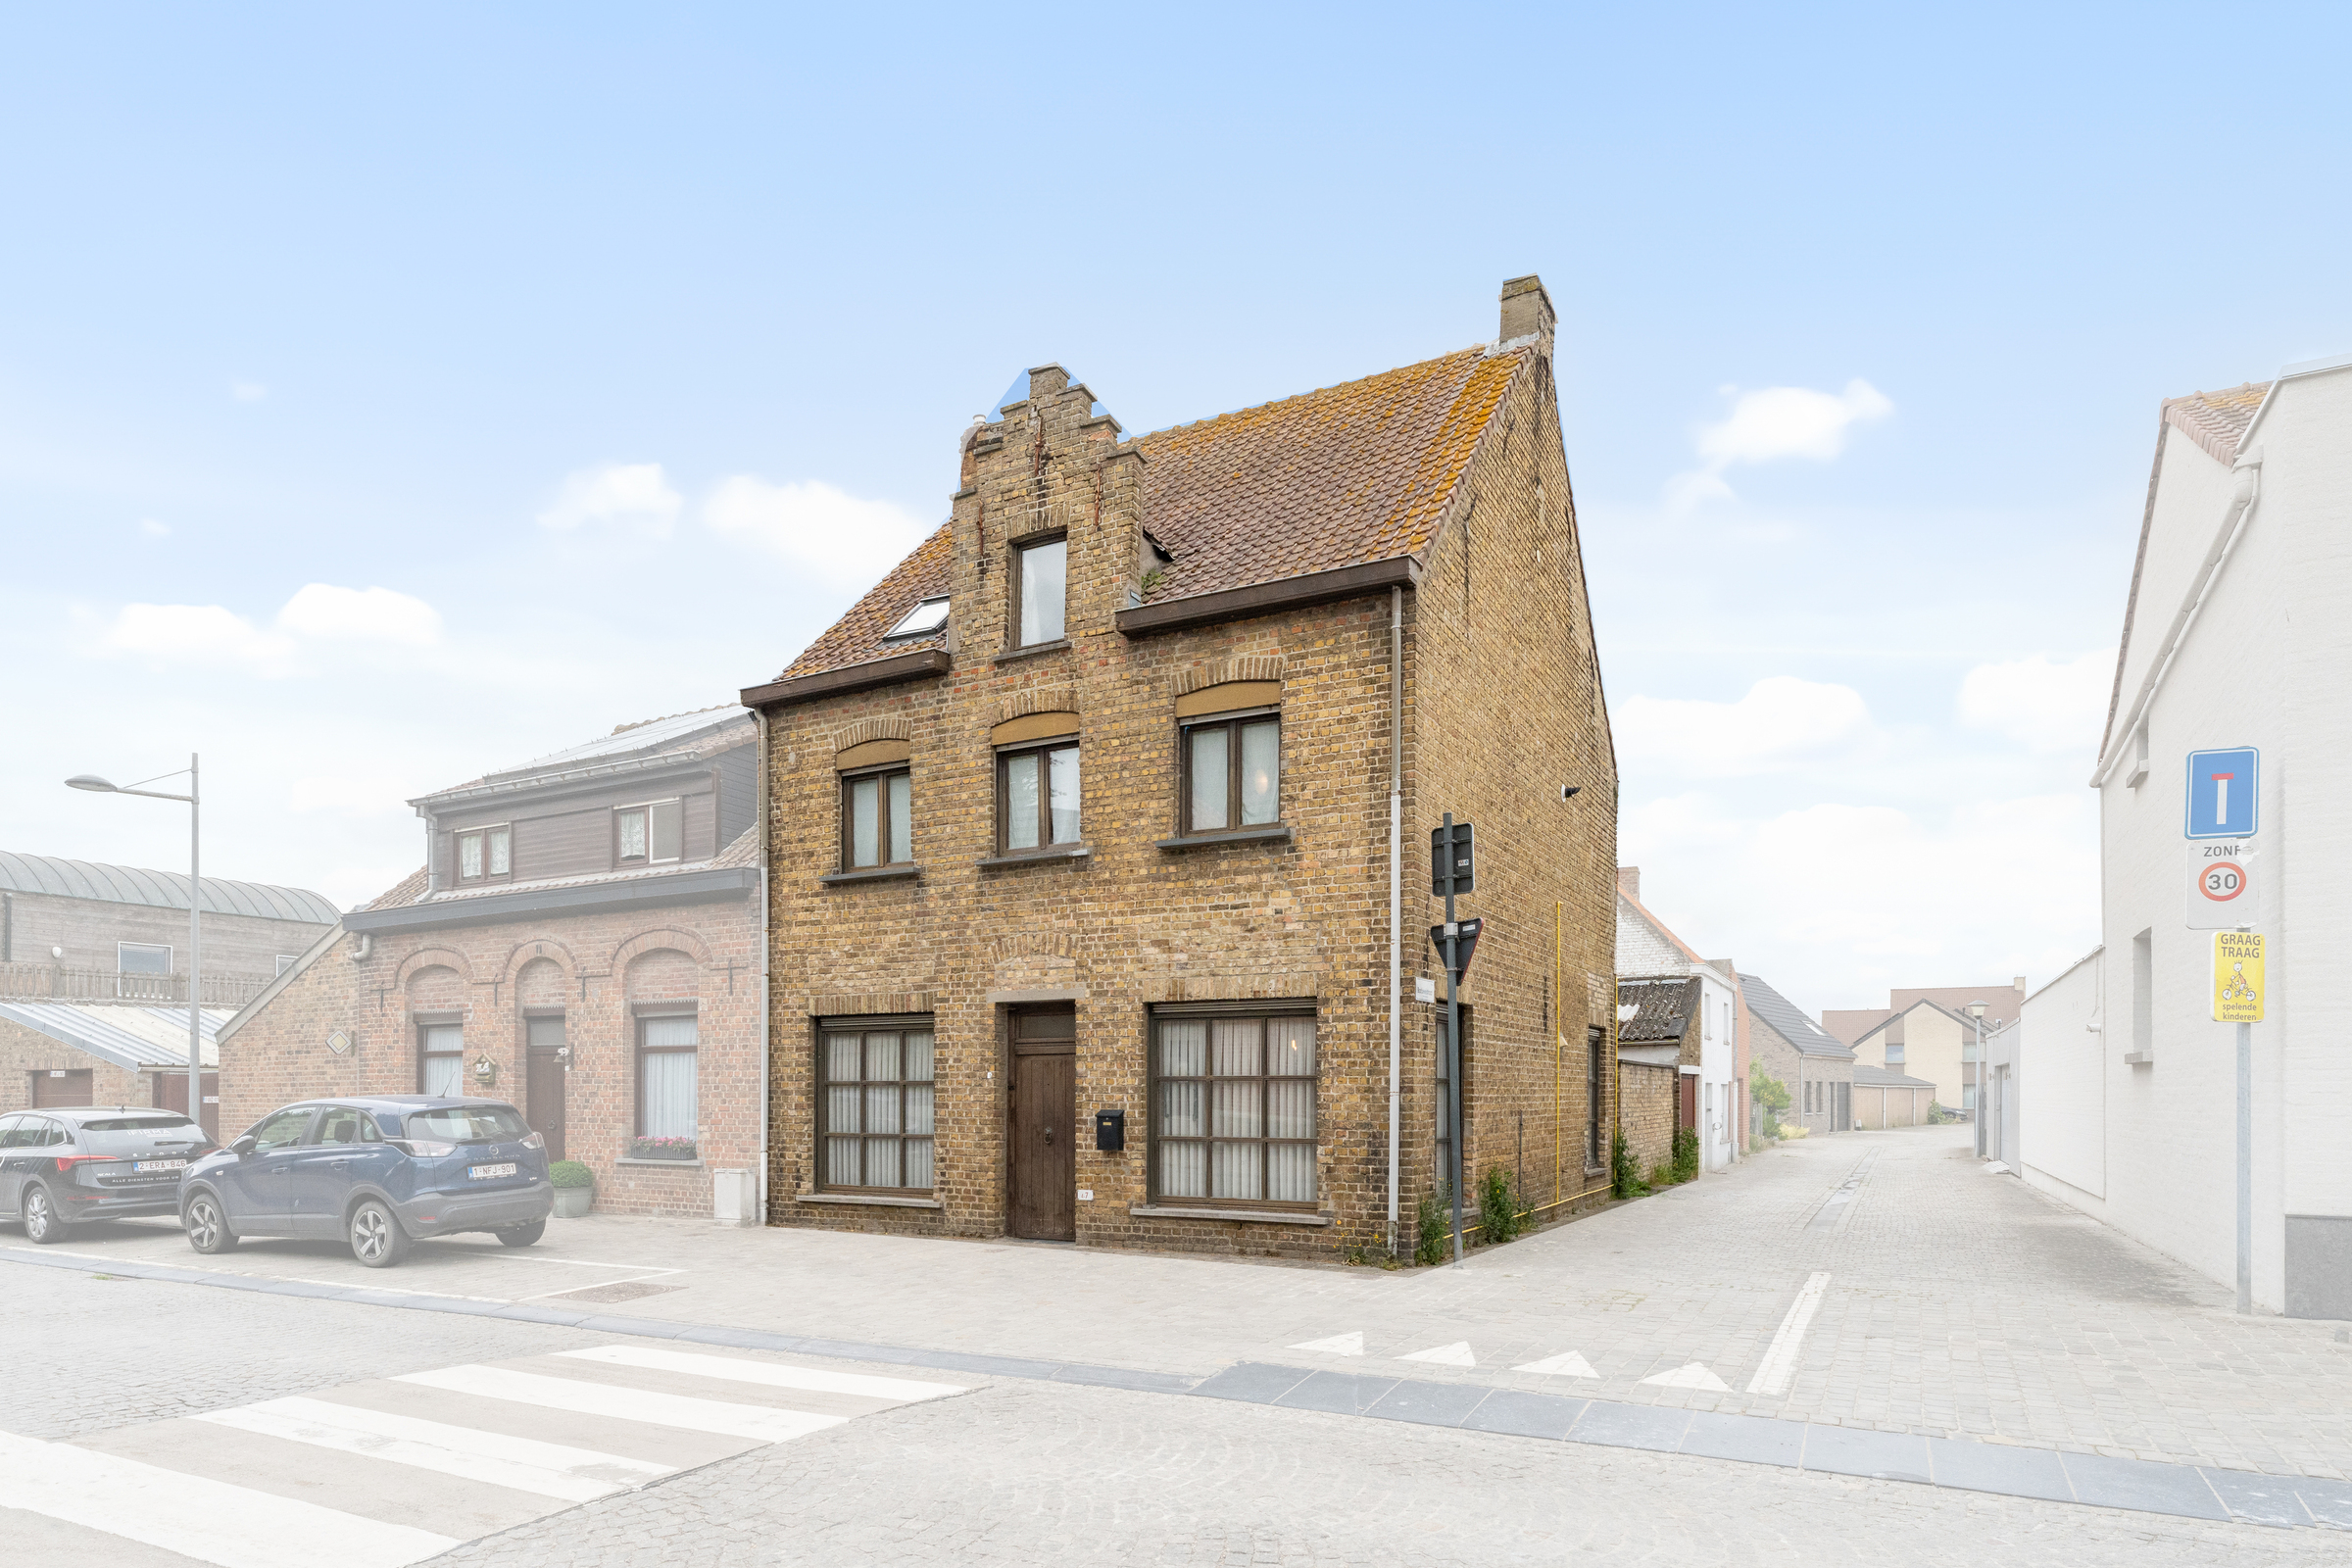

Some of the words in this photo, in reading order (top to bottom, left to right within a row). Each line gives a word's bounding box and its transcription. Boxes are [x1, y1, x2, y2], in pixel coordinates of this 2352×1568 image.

[2208, 873, 2238, 890] 30
[2220, 934, 2261, 946] GRAAG
[2221, 947, 2260, 958] TRAAG
[2222, 1003, 2257, 1011] spelende
[2222, 1012, 2257, 1021] kinderen
[138, 1160, 186, 1170] 2-ERA-846
[473, 1164, 515, 1176] 1-NFJ-901
